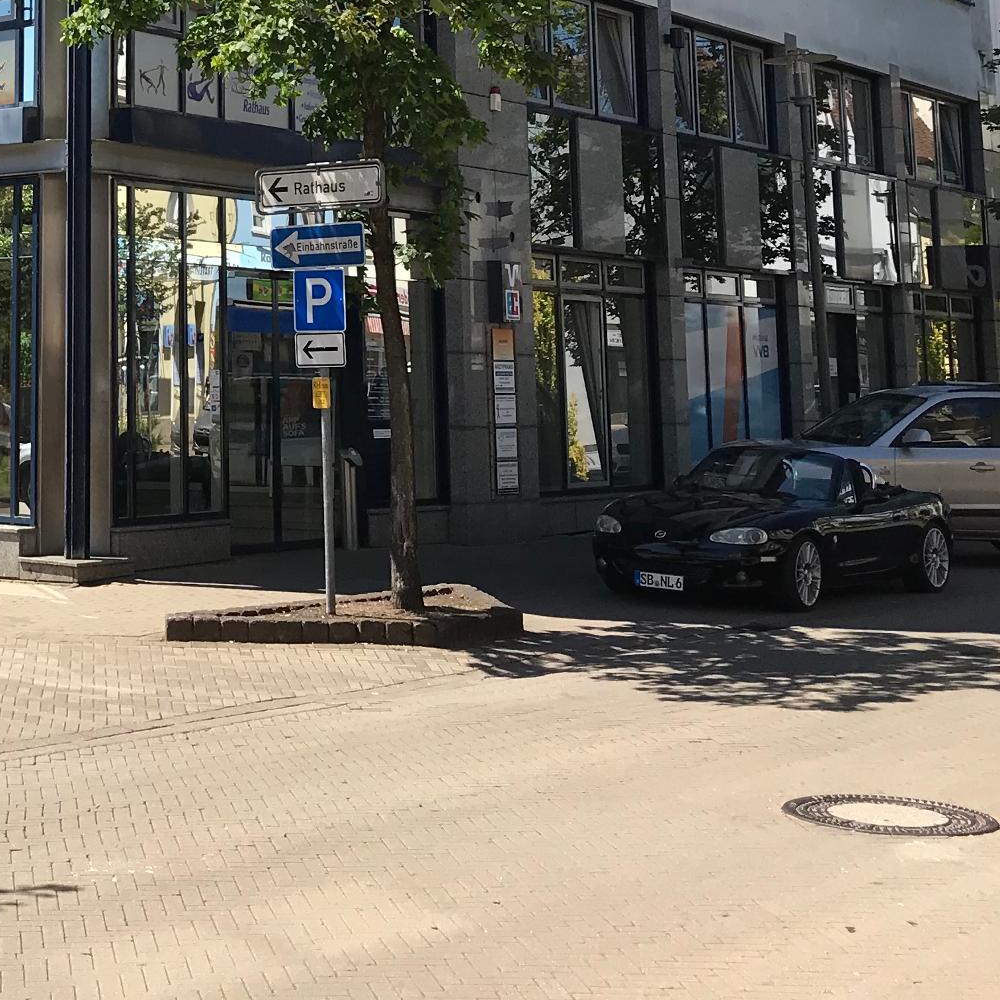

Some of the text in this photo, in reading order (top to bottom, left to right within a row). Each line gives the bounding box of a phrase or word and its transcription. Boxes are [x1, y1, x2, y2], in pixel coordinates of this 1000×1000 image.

[242, 99, 270, 116] Rathaus
[294, 181, 346, 196] Rathaus
[296, 239, 359, 253] Einbahnstraße
[305, 277, 333, 324] P
[640, 573, 682, 589] SB NL 6
